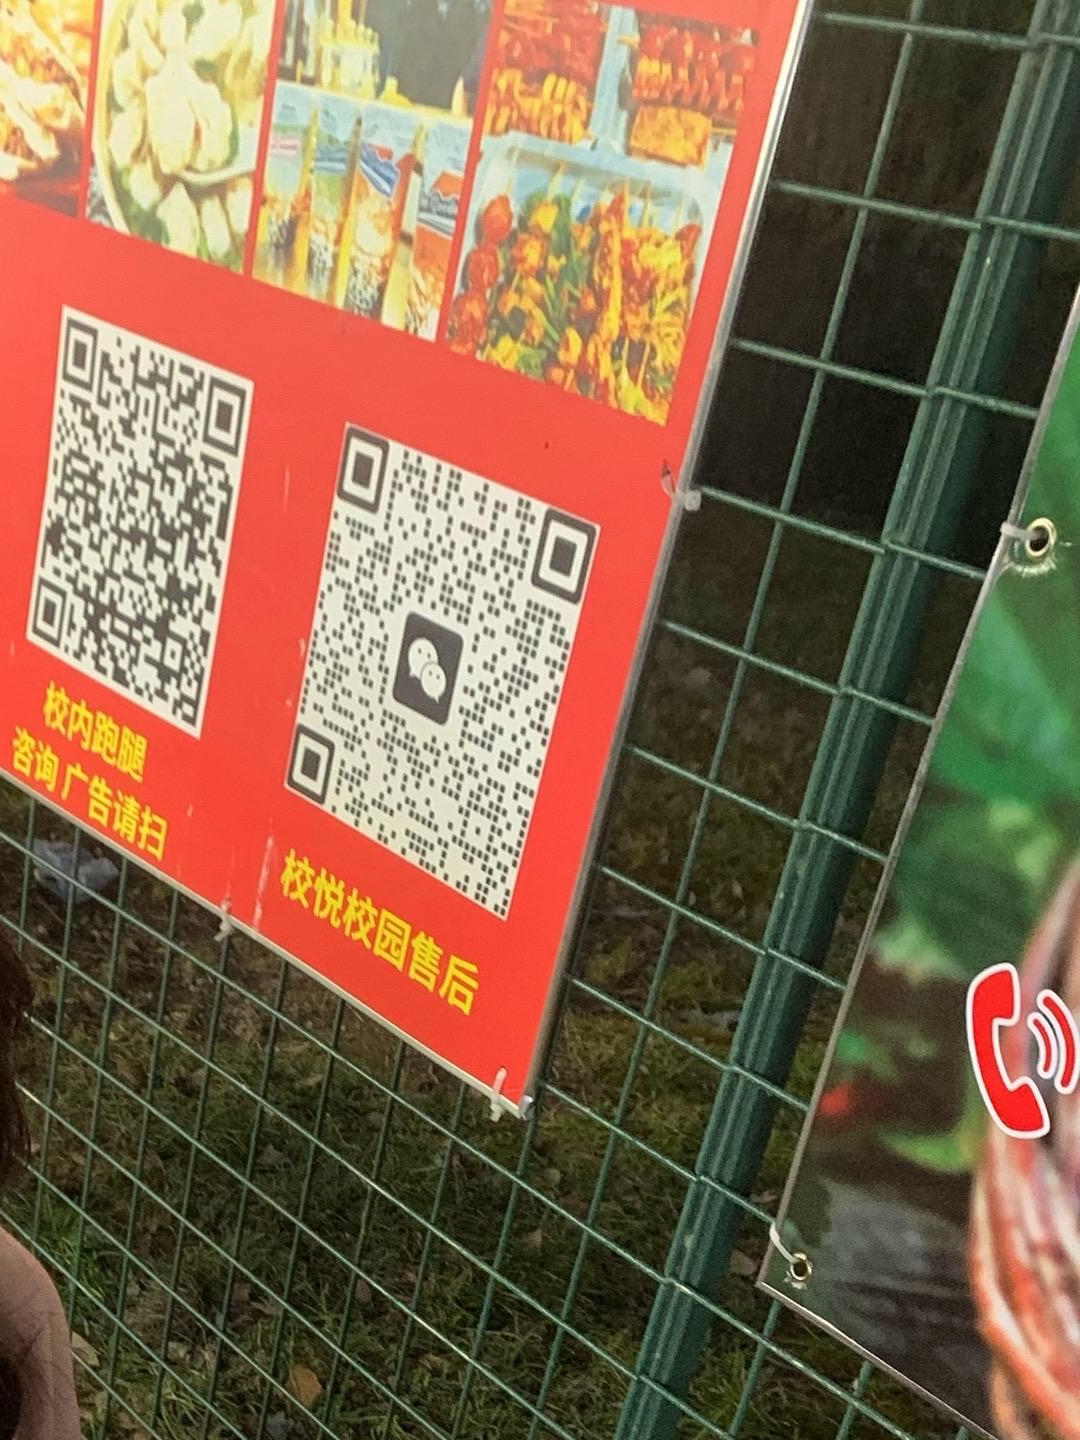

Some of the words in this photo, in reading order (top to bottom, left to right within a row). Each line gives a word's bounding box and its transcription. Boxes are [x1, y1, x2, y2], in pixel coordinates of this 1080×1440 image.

[11, 725, 169, 862] 咨询广告请扫
[42, 680, 149, 783] 校内跑腿
[280, 848, 480, 1016] 校悦校园售后
